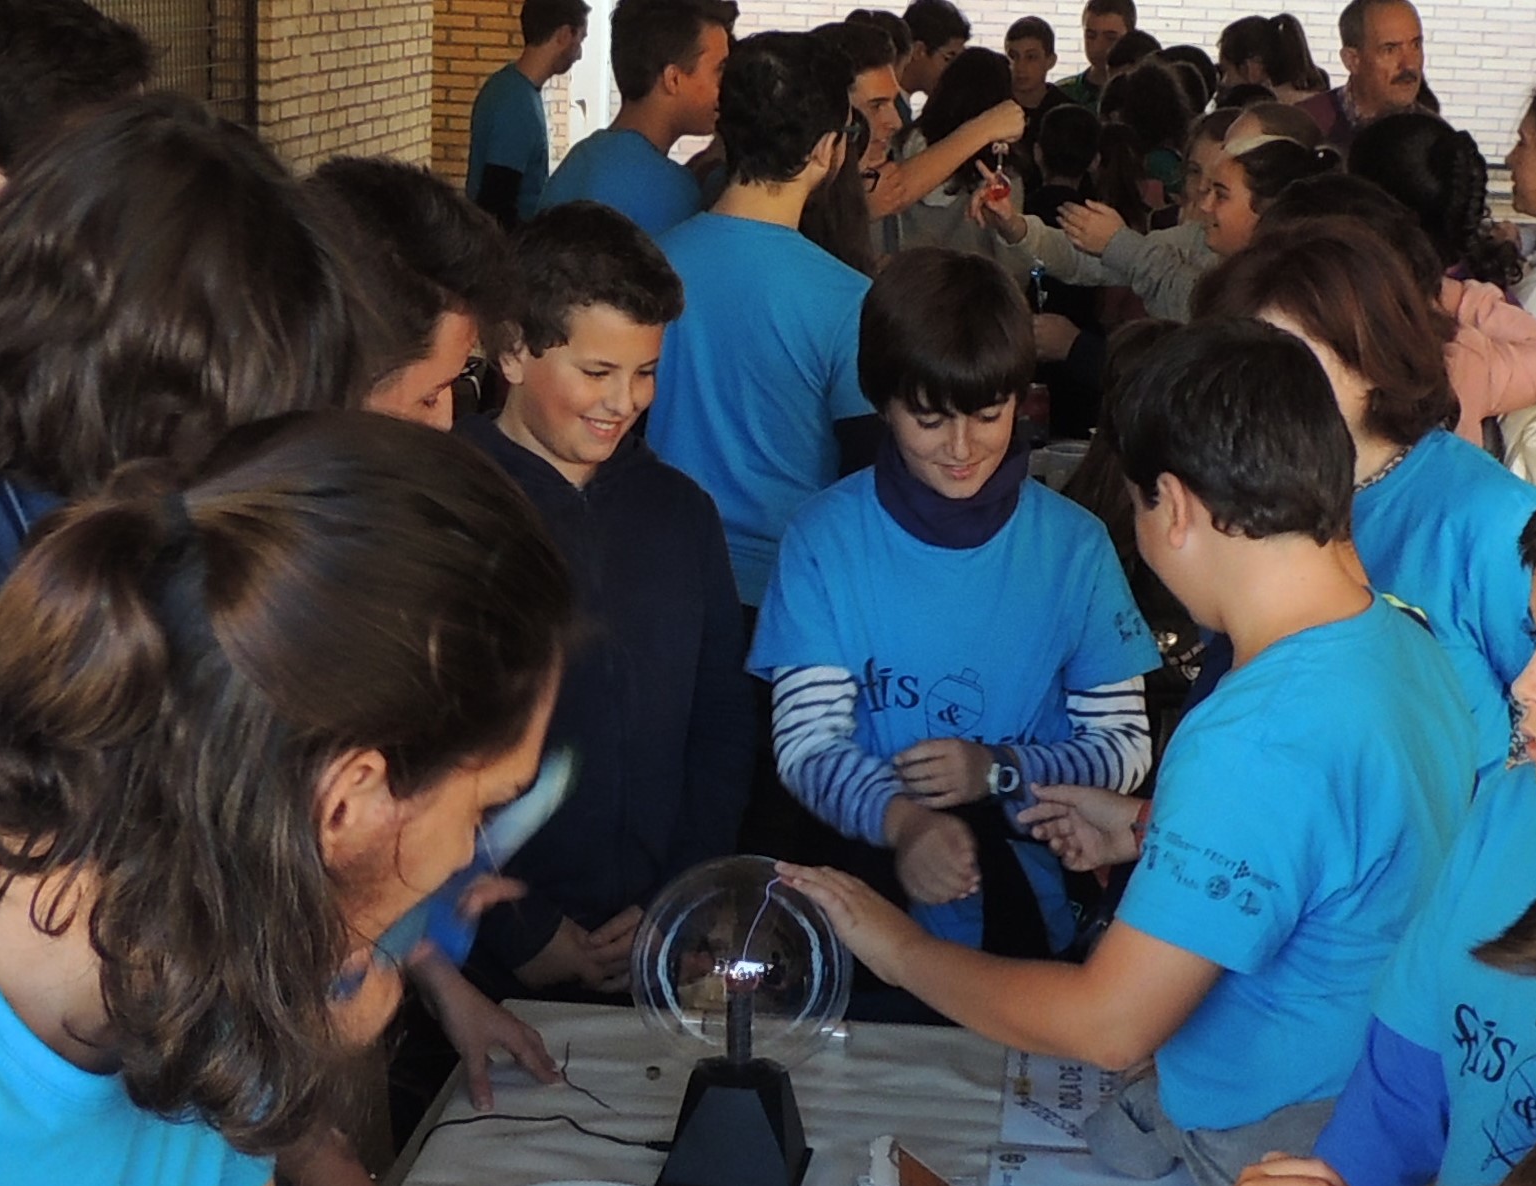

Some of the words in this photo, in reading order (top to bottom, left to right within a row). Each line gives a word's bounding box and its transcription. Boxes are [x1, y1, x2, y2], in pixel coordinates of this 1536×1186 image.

[937, 703, 962, 727] &
[1451, 1003, 1517, 1083] fis
[1058, 1064, 1083, 1081] DE
[1058, 1082, 1083, 1110] BOLA
